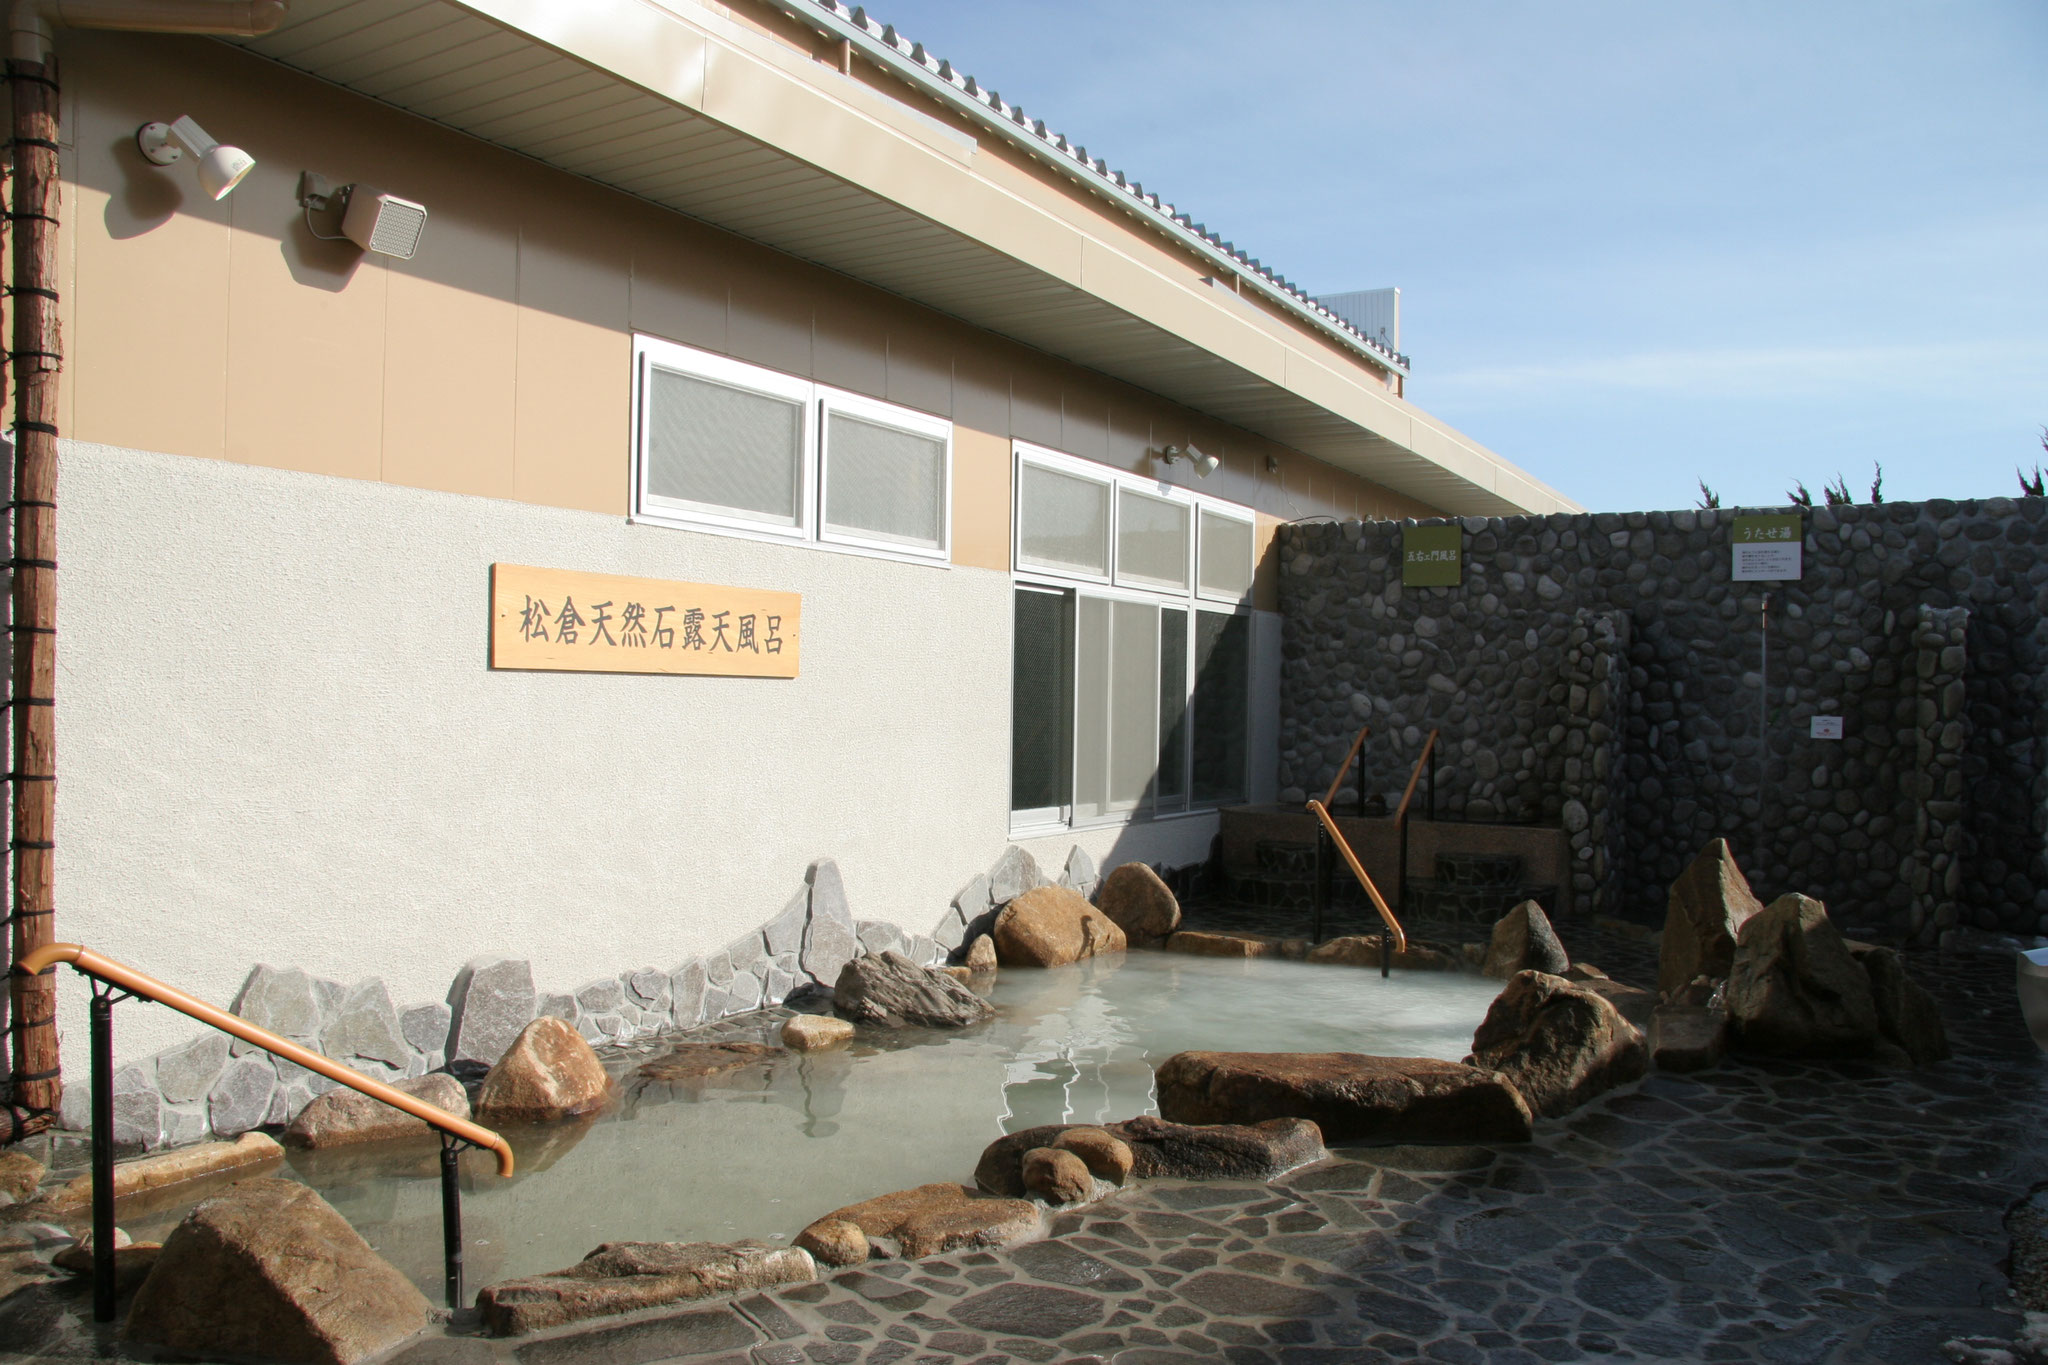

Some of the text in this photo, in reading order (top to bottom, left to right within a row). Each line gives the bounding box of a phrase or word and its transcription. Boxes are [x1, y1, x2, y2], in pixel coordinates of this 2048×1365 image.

[1743, 526, 1792, 540] うたせ湯
[519, 594, 783, 655] 松倉天然石露天風呂
